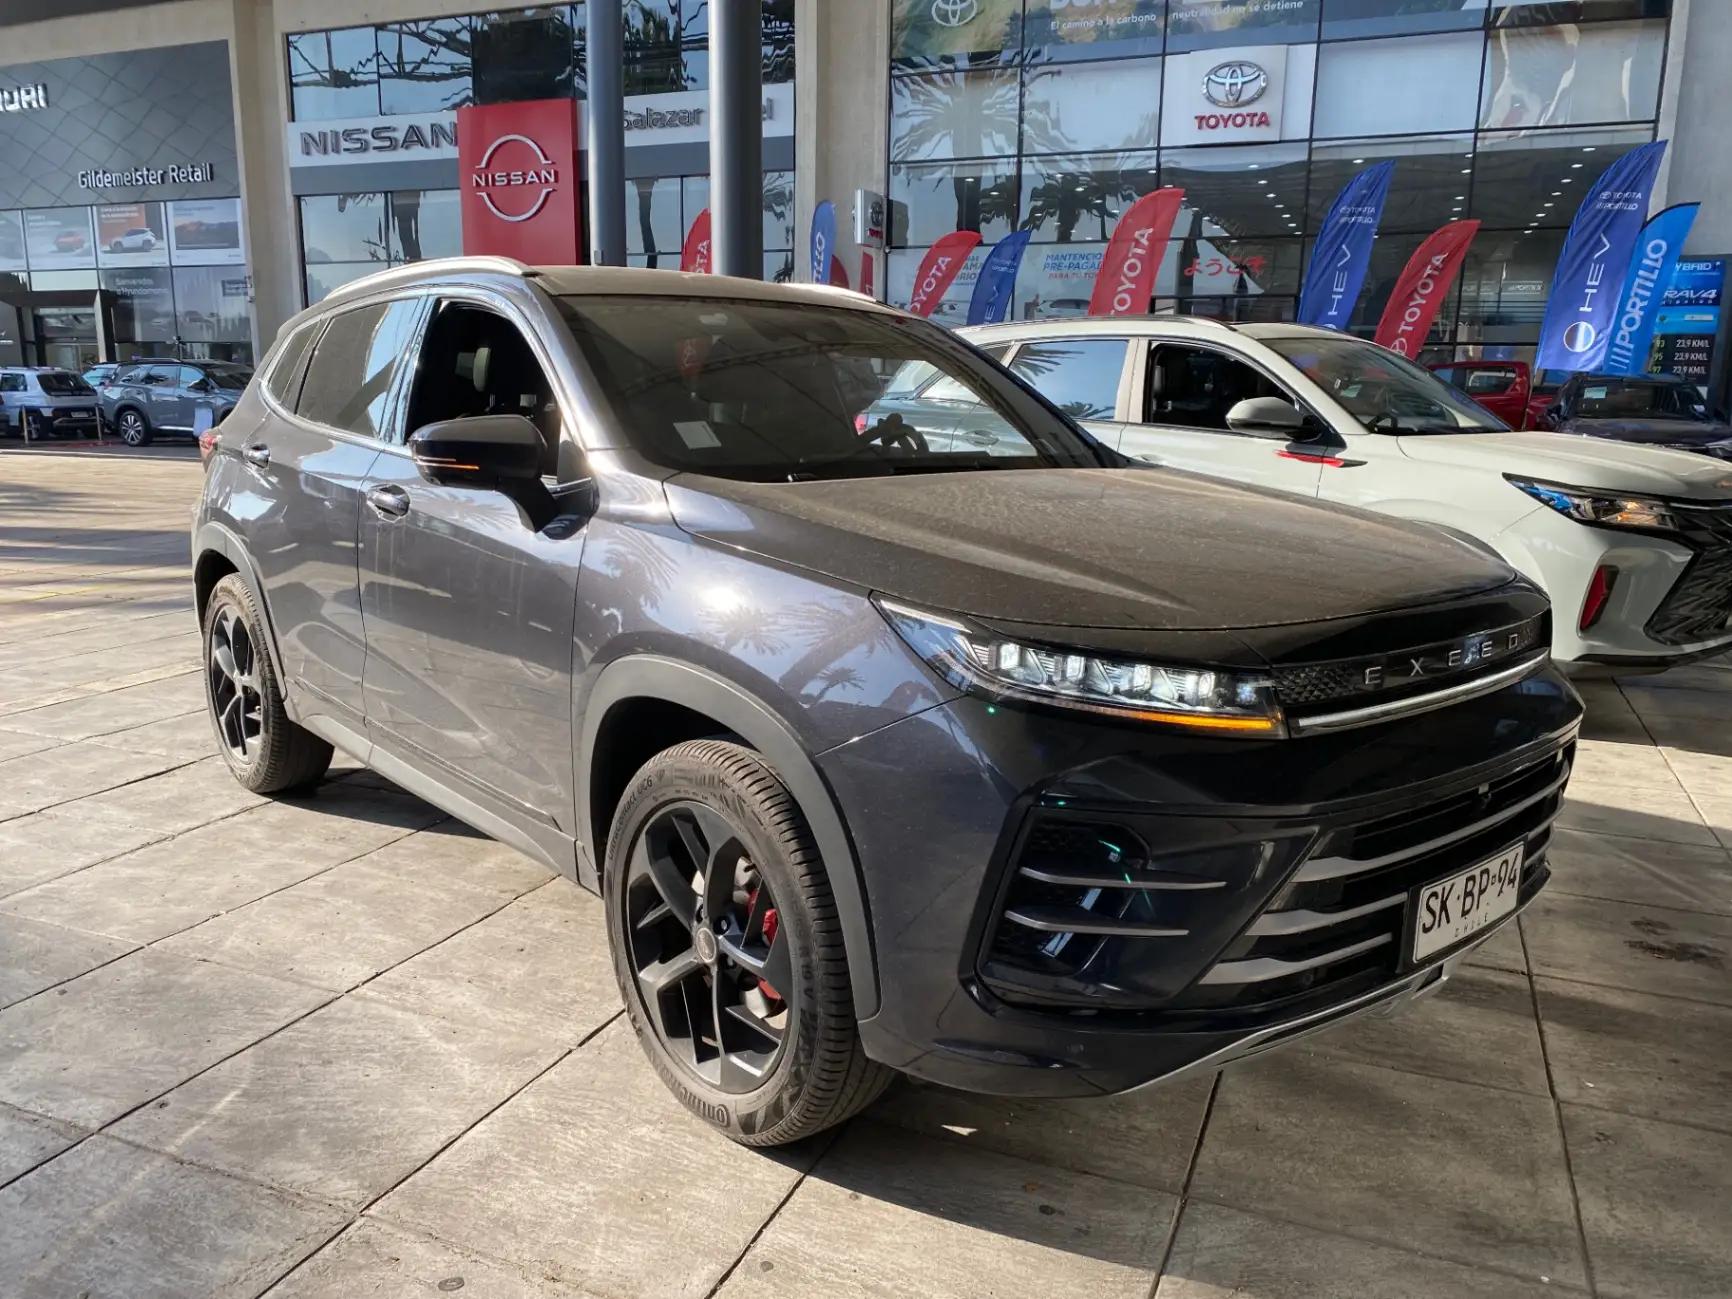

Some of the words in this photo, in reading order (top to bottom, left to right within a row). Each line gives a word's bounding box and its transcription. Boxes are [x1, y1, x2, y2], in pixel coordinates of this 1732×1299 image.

[1116, 12, 1157, 25] carbono
[1263, 1, 1304, 12] detiene
[624, 107, 705, 131] Salazar
[1195, 111, 1270, 130] TOYOTA
[300, 121, 458, 156] NISSAN
[78, 167, 165, 189] Gildemeister
[168, 162, 213, 183] Retail
[472, 168, 557, 188] NISSAN
[1043, 262, 1104, 271] PRE-PAGAD
[1111, 227, 1154, 315] OYOTA
[1327, 244, 1351, 316] HEV
[1578, 232, 1611, 312] HEV
[1675, 261, 1712, 272] YBRID
[910, 256, 952, 316] OYOTA
[1398, 252, 1448, 334] TOYOTA
[1663, 288, 1718, 300] RAV4
[1364, 633, 1519, 686] EXEED
